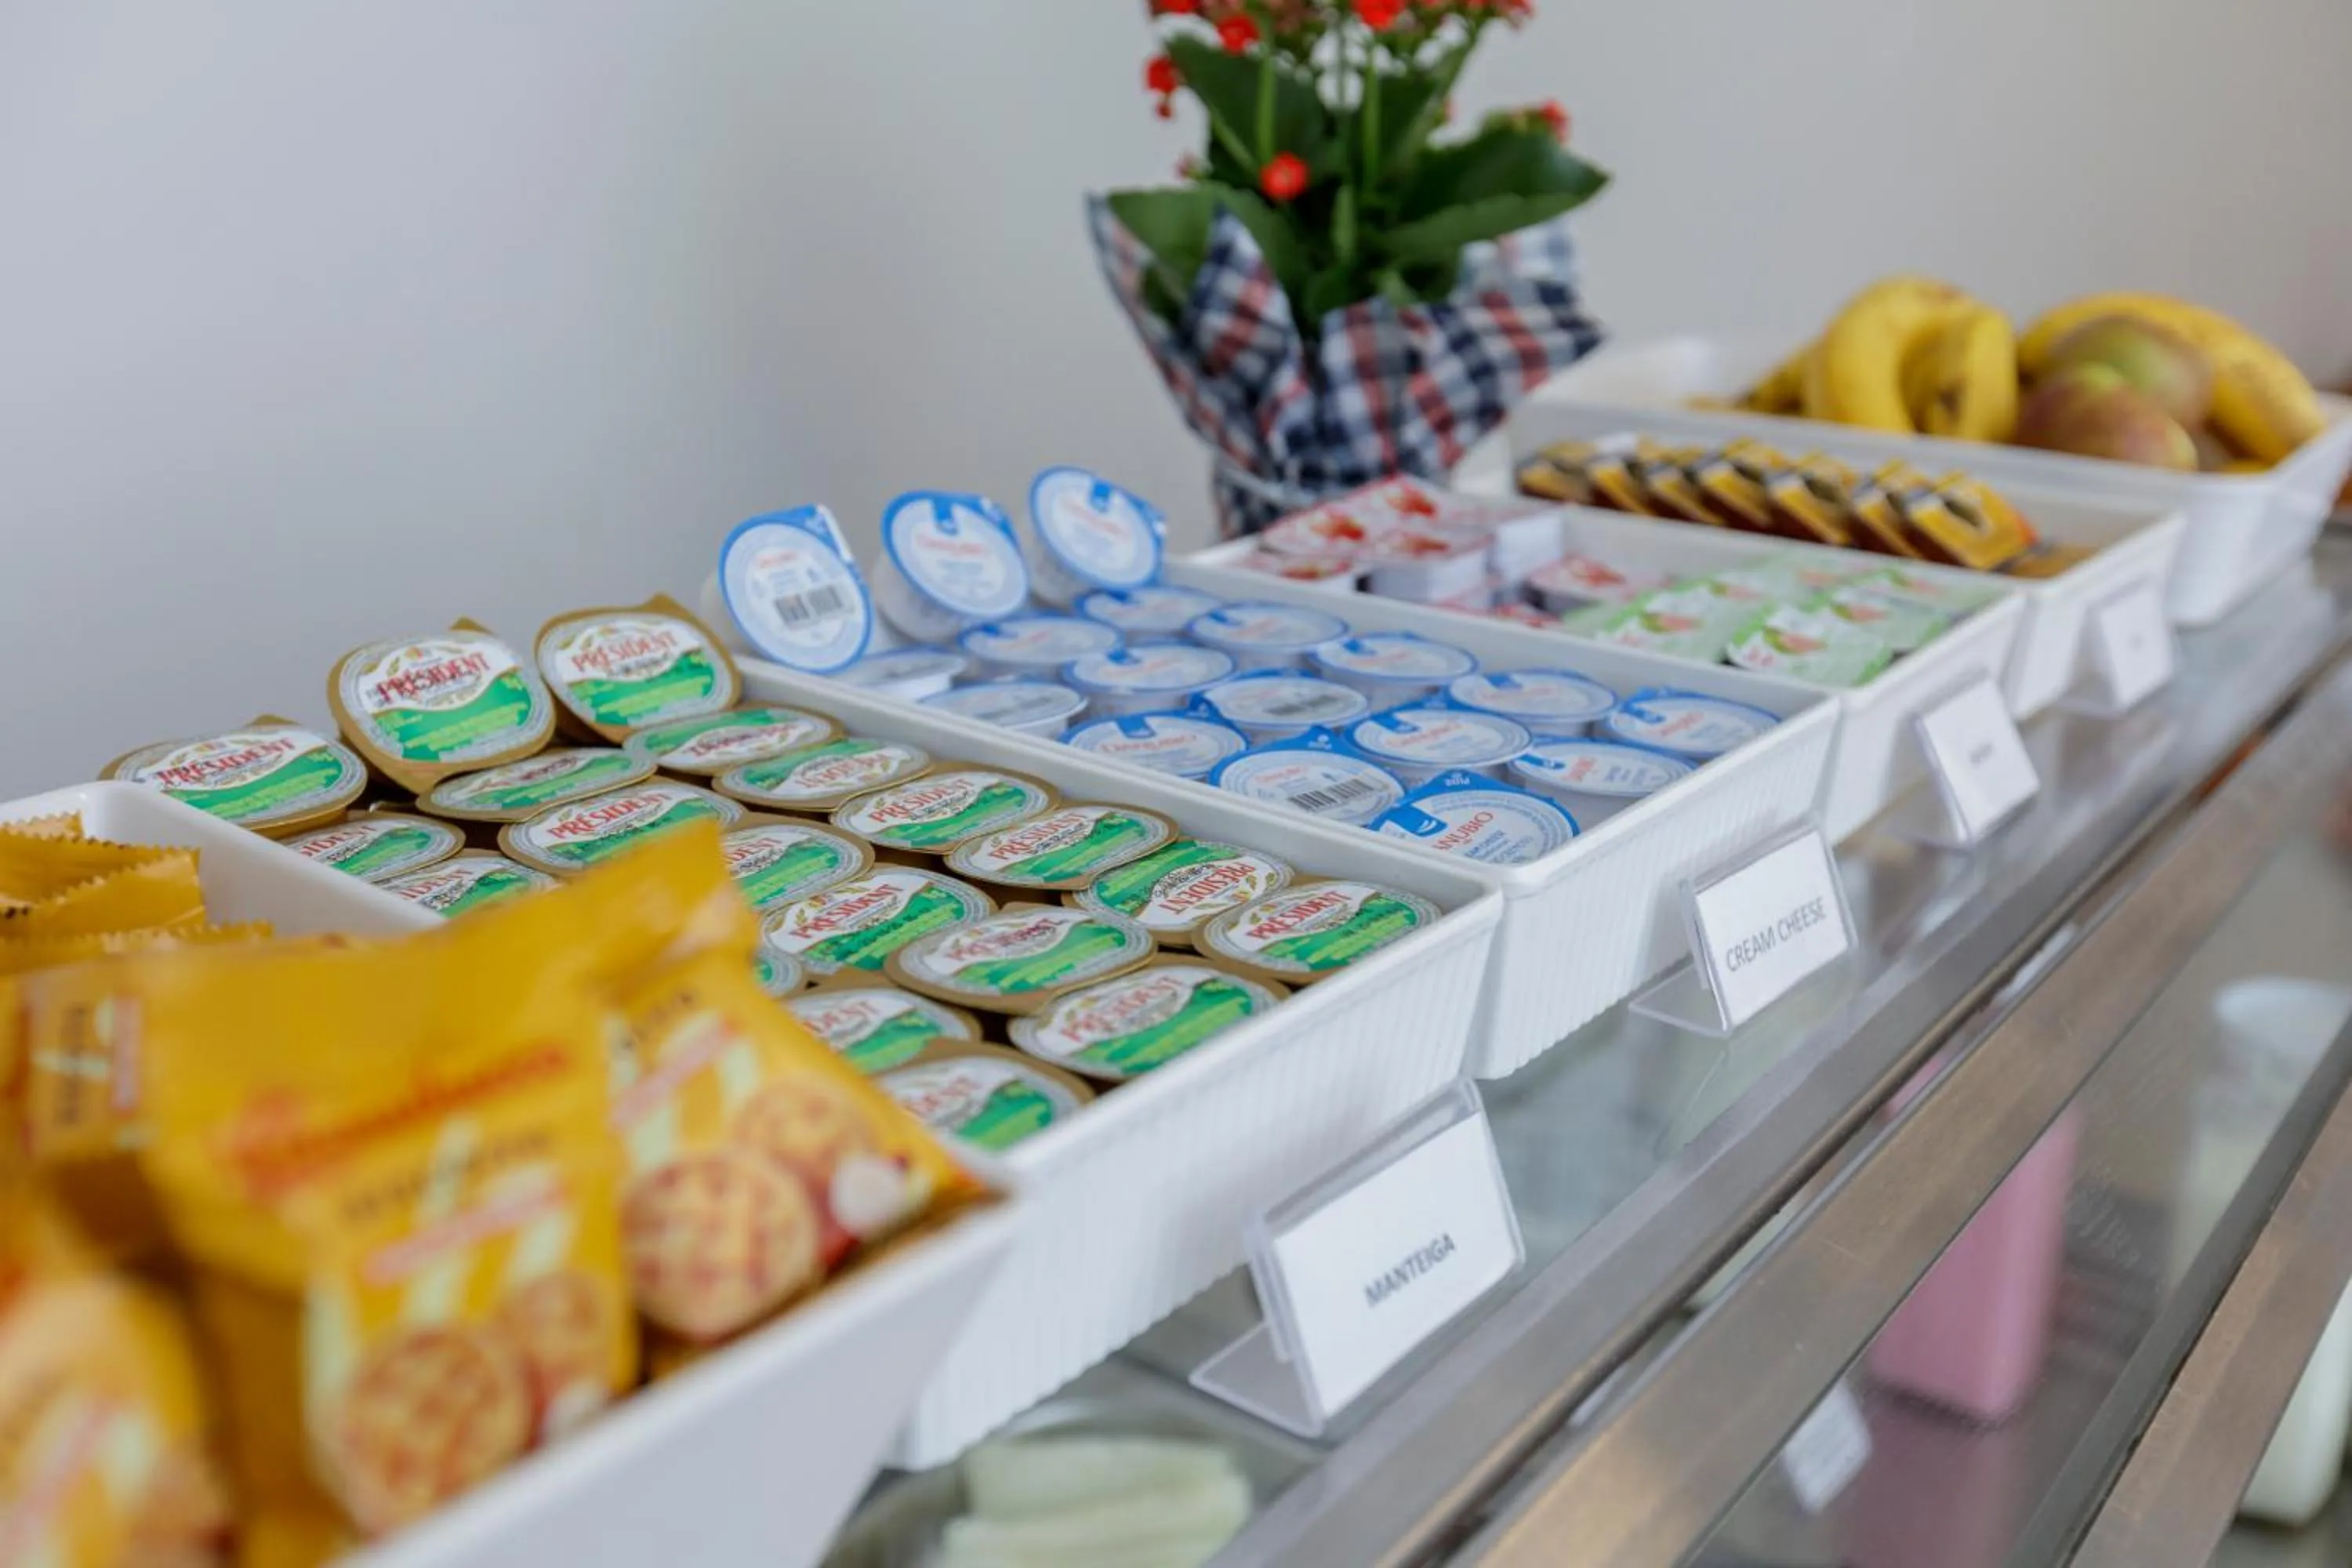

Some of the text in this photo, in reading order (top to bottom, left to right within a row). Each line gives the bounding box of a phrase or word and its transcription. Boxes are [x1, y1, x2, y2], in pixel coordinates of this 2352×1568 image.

[1726, 895, 1828, 973] CREAM CHEESE
[1363, 1232, 1457, 1310] MANTEIGA
